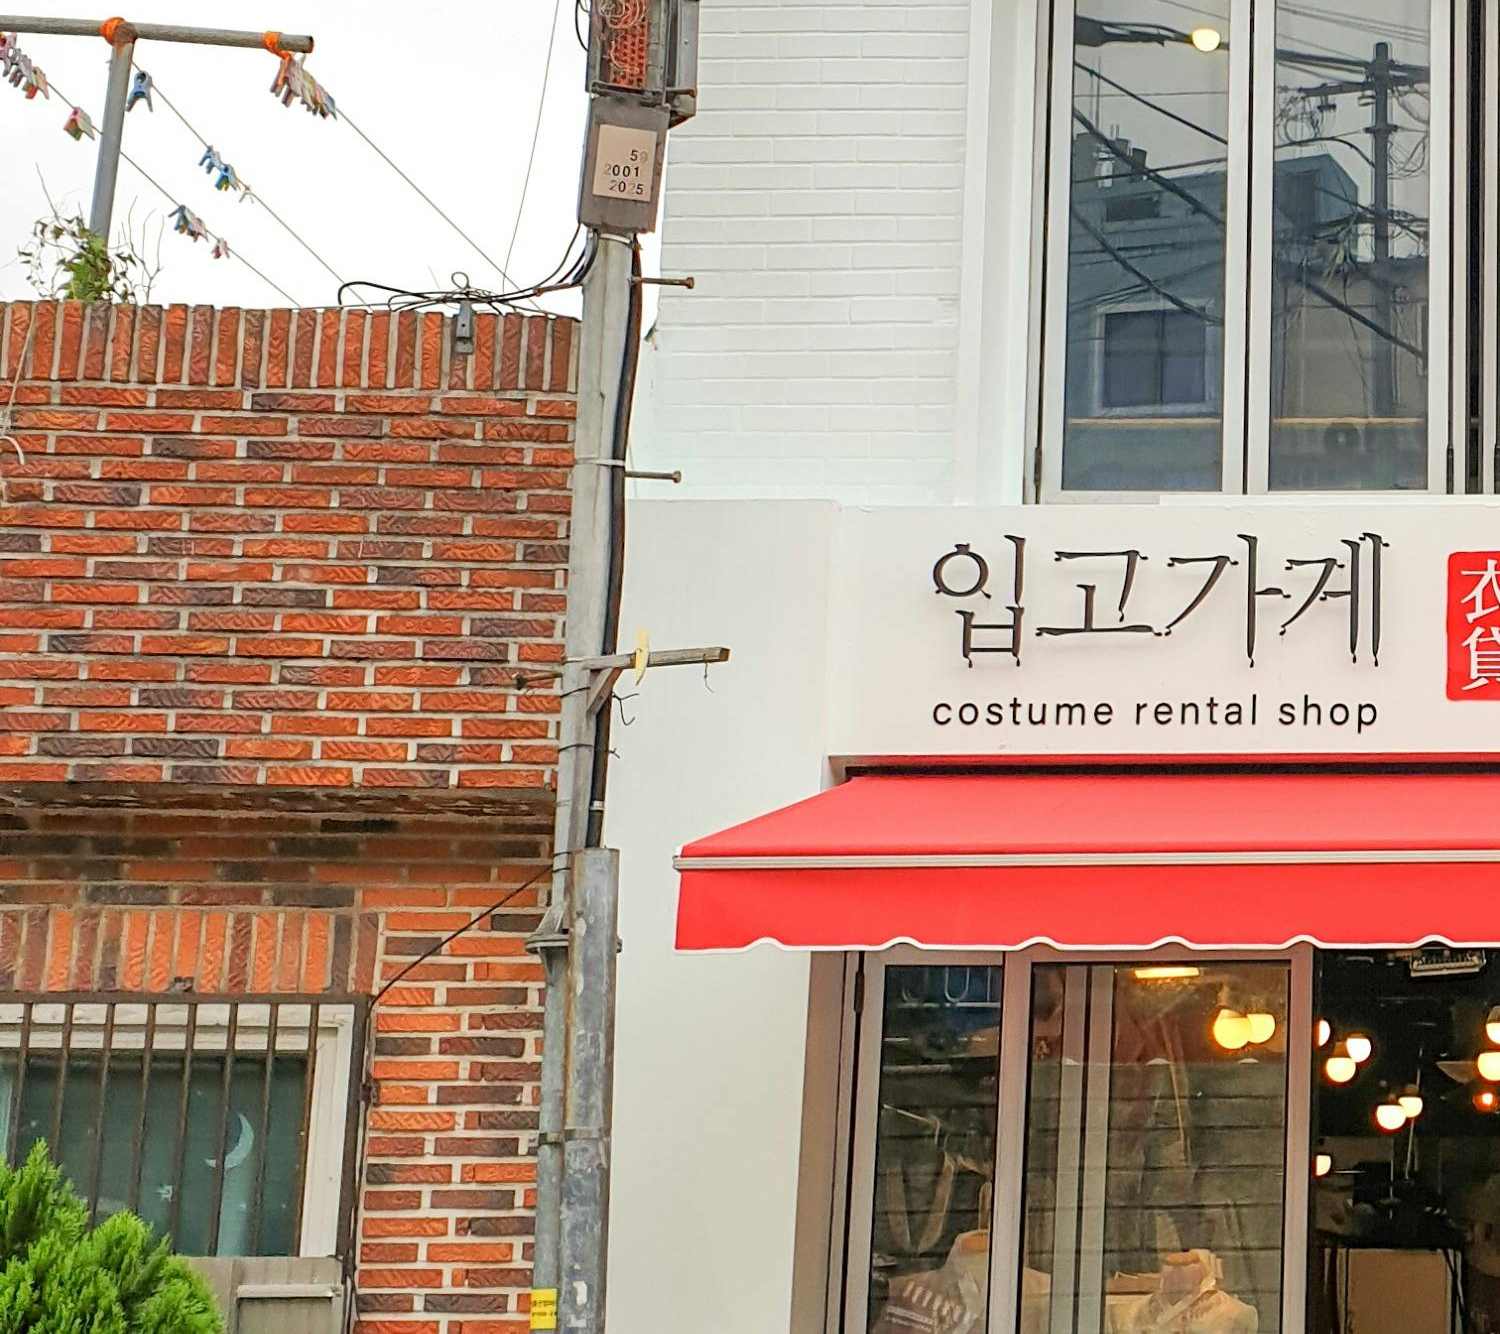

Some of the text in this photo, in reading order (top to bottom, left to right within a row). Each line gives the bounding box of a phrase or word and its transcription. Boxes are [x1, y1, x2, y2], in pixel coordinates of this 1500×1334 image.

[933, 532, 1390, 668] 입고가게
[932, 694, 1379, 734] costume rental shop
